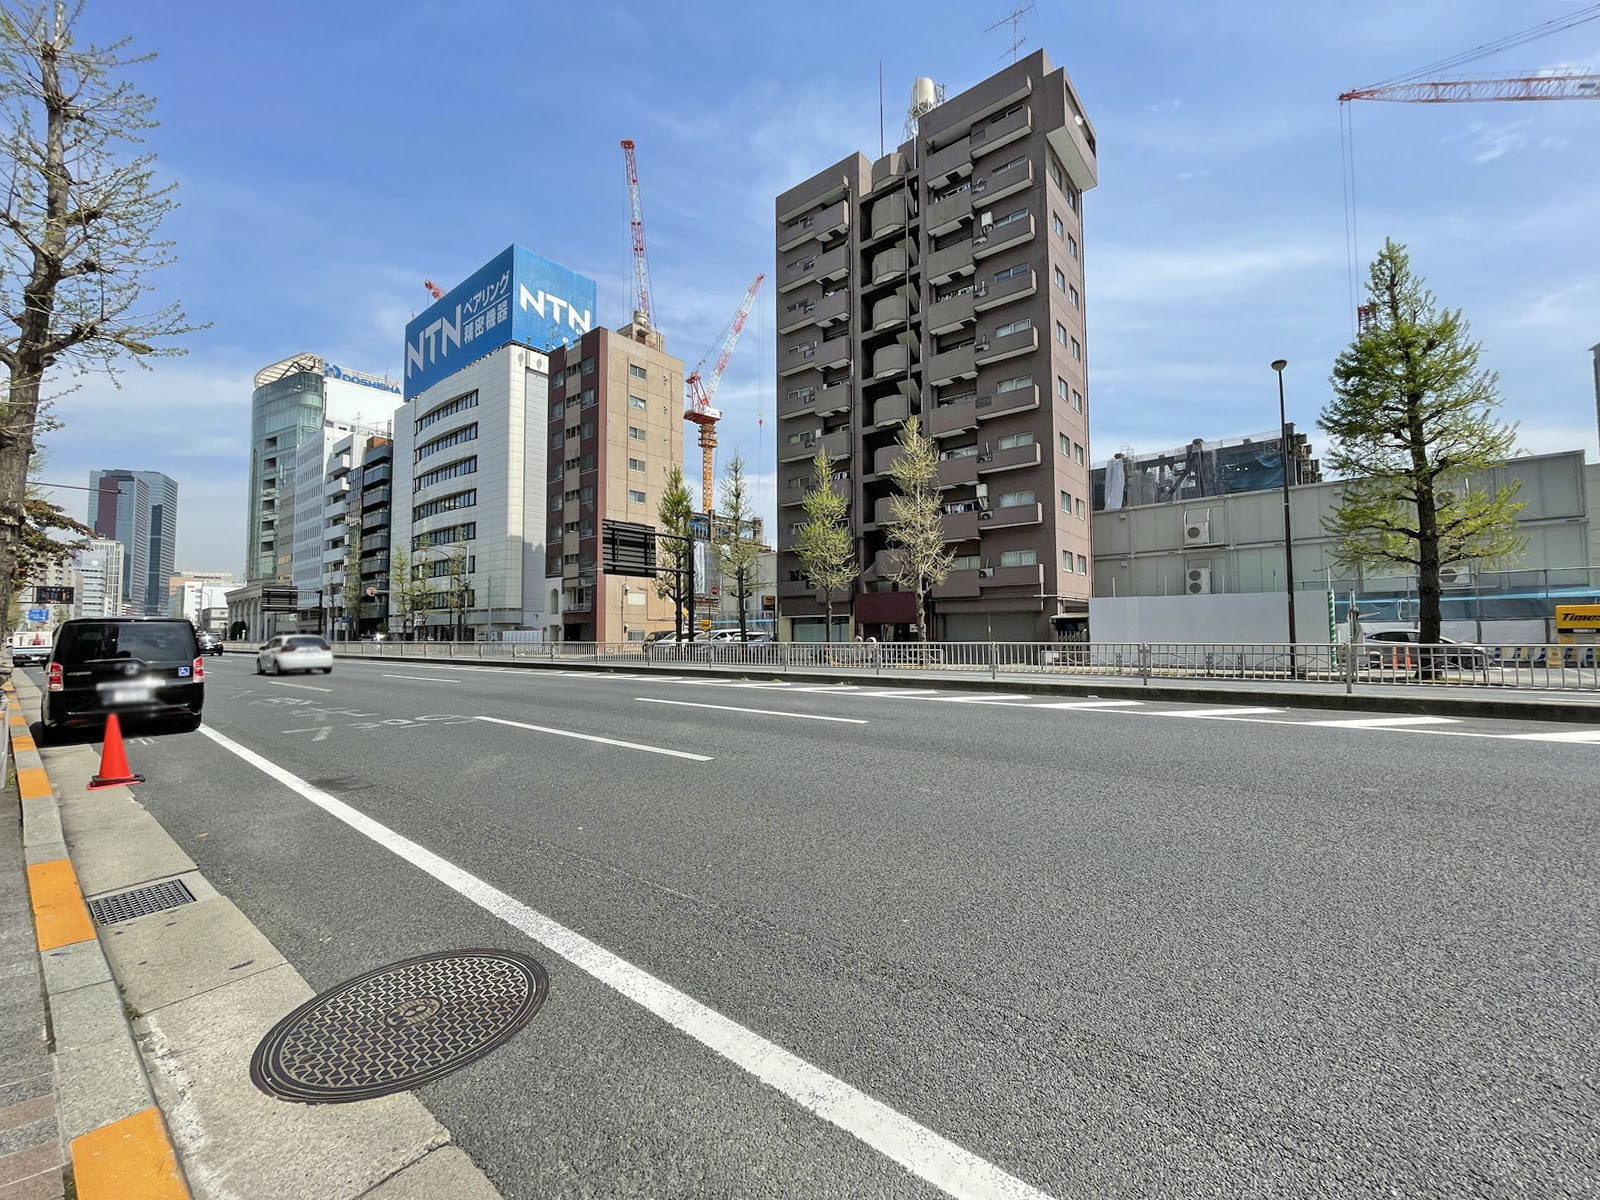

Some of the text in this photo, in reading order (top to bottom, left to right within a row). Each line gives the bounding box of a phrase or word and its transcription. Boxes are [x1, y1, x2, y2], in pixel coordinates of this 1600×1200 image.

[463, 270, 510, 315] ベアリング
[520, 283, 591, 333] NTN
[407, 304, 461, 379] NTN
[463, 299, 509, 344] 精密機器
[342, 374, 402, 395] DOSHISHA
[1562, 613, 1600, 621] Times
